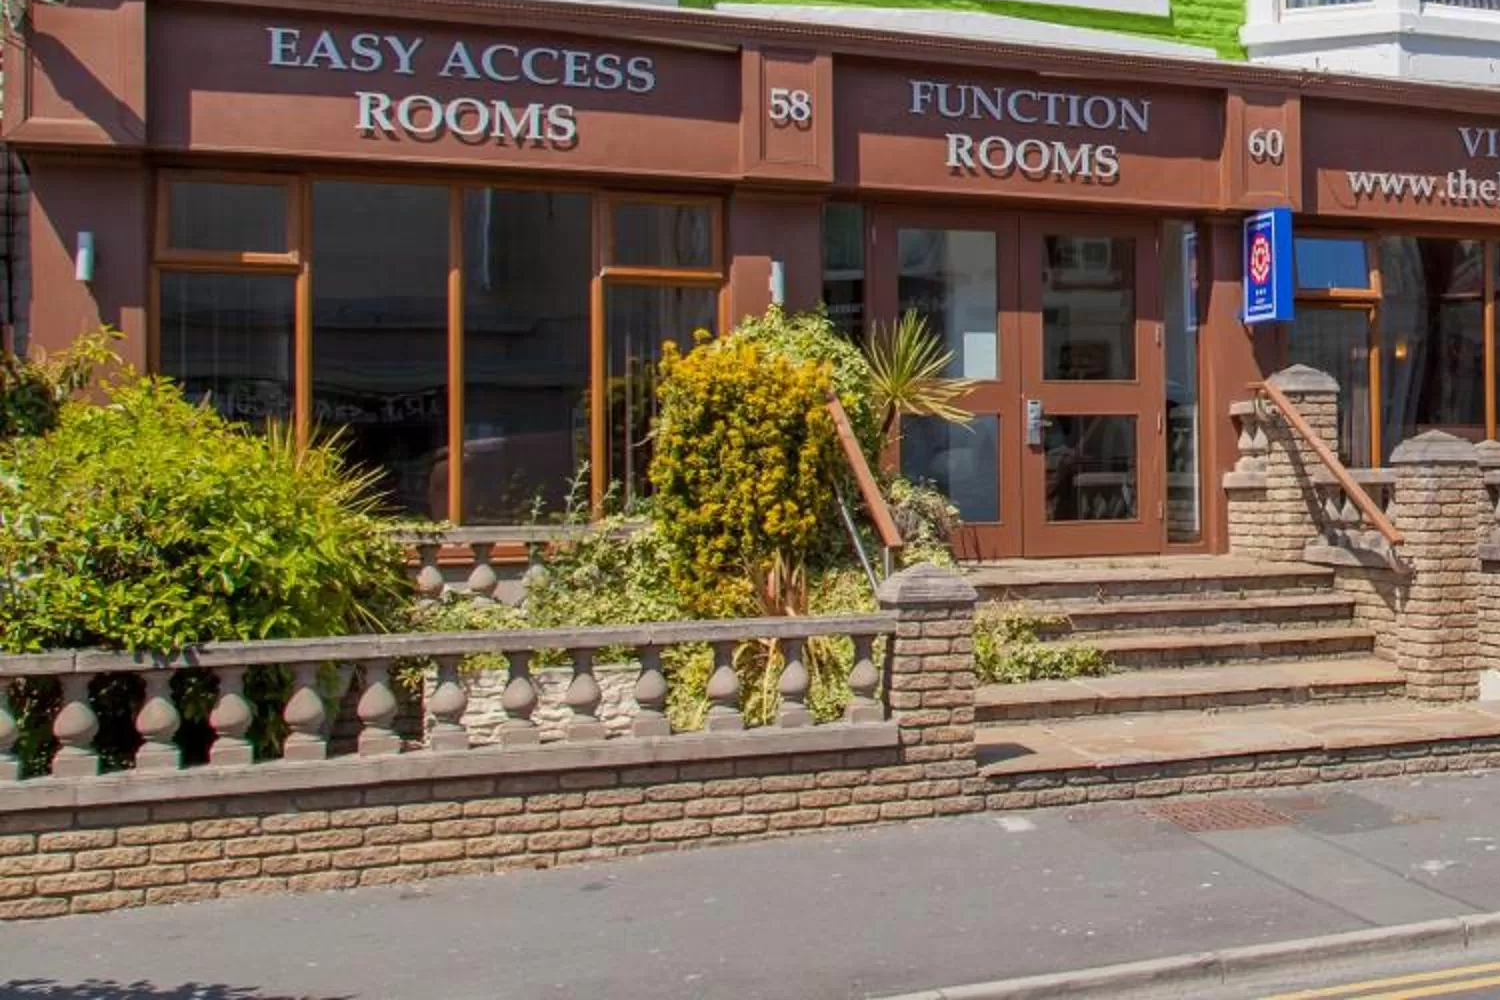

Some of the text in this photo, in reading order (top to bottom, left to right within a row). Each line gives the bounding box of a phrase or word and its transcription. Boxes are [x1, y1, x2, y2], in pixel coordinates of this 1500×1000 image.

[265, 26, 657, 94] EASY ACCESS
[354, 91, 579, 142] ROOMS
[769, 87, 811, 122] 58
[908, 79, 1152, 133] FUNCTION
[944, 132, 1120, 178] ROOMS
[1248, 128, 1284, 159] 60
